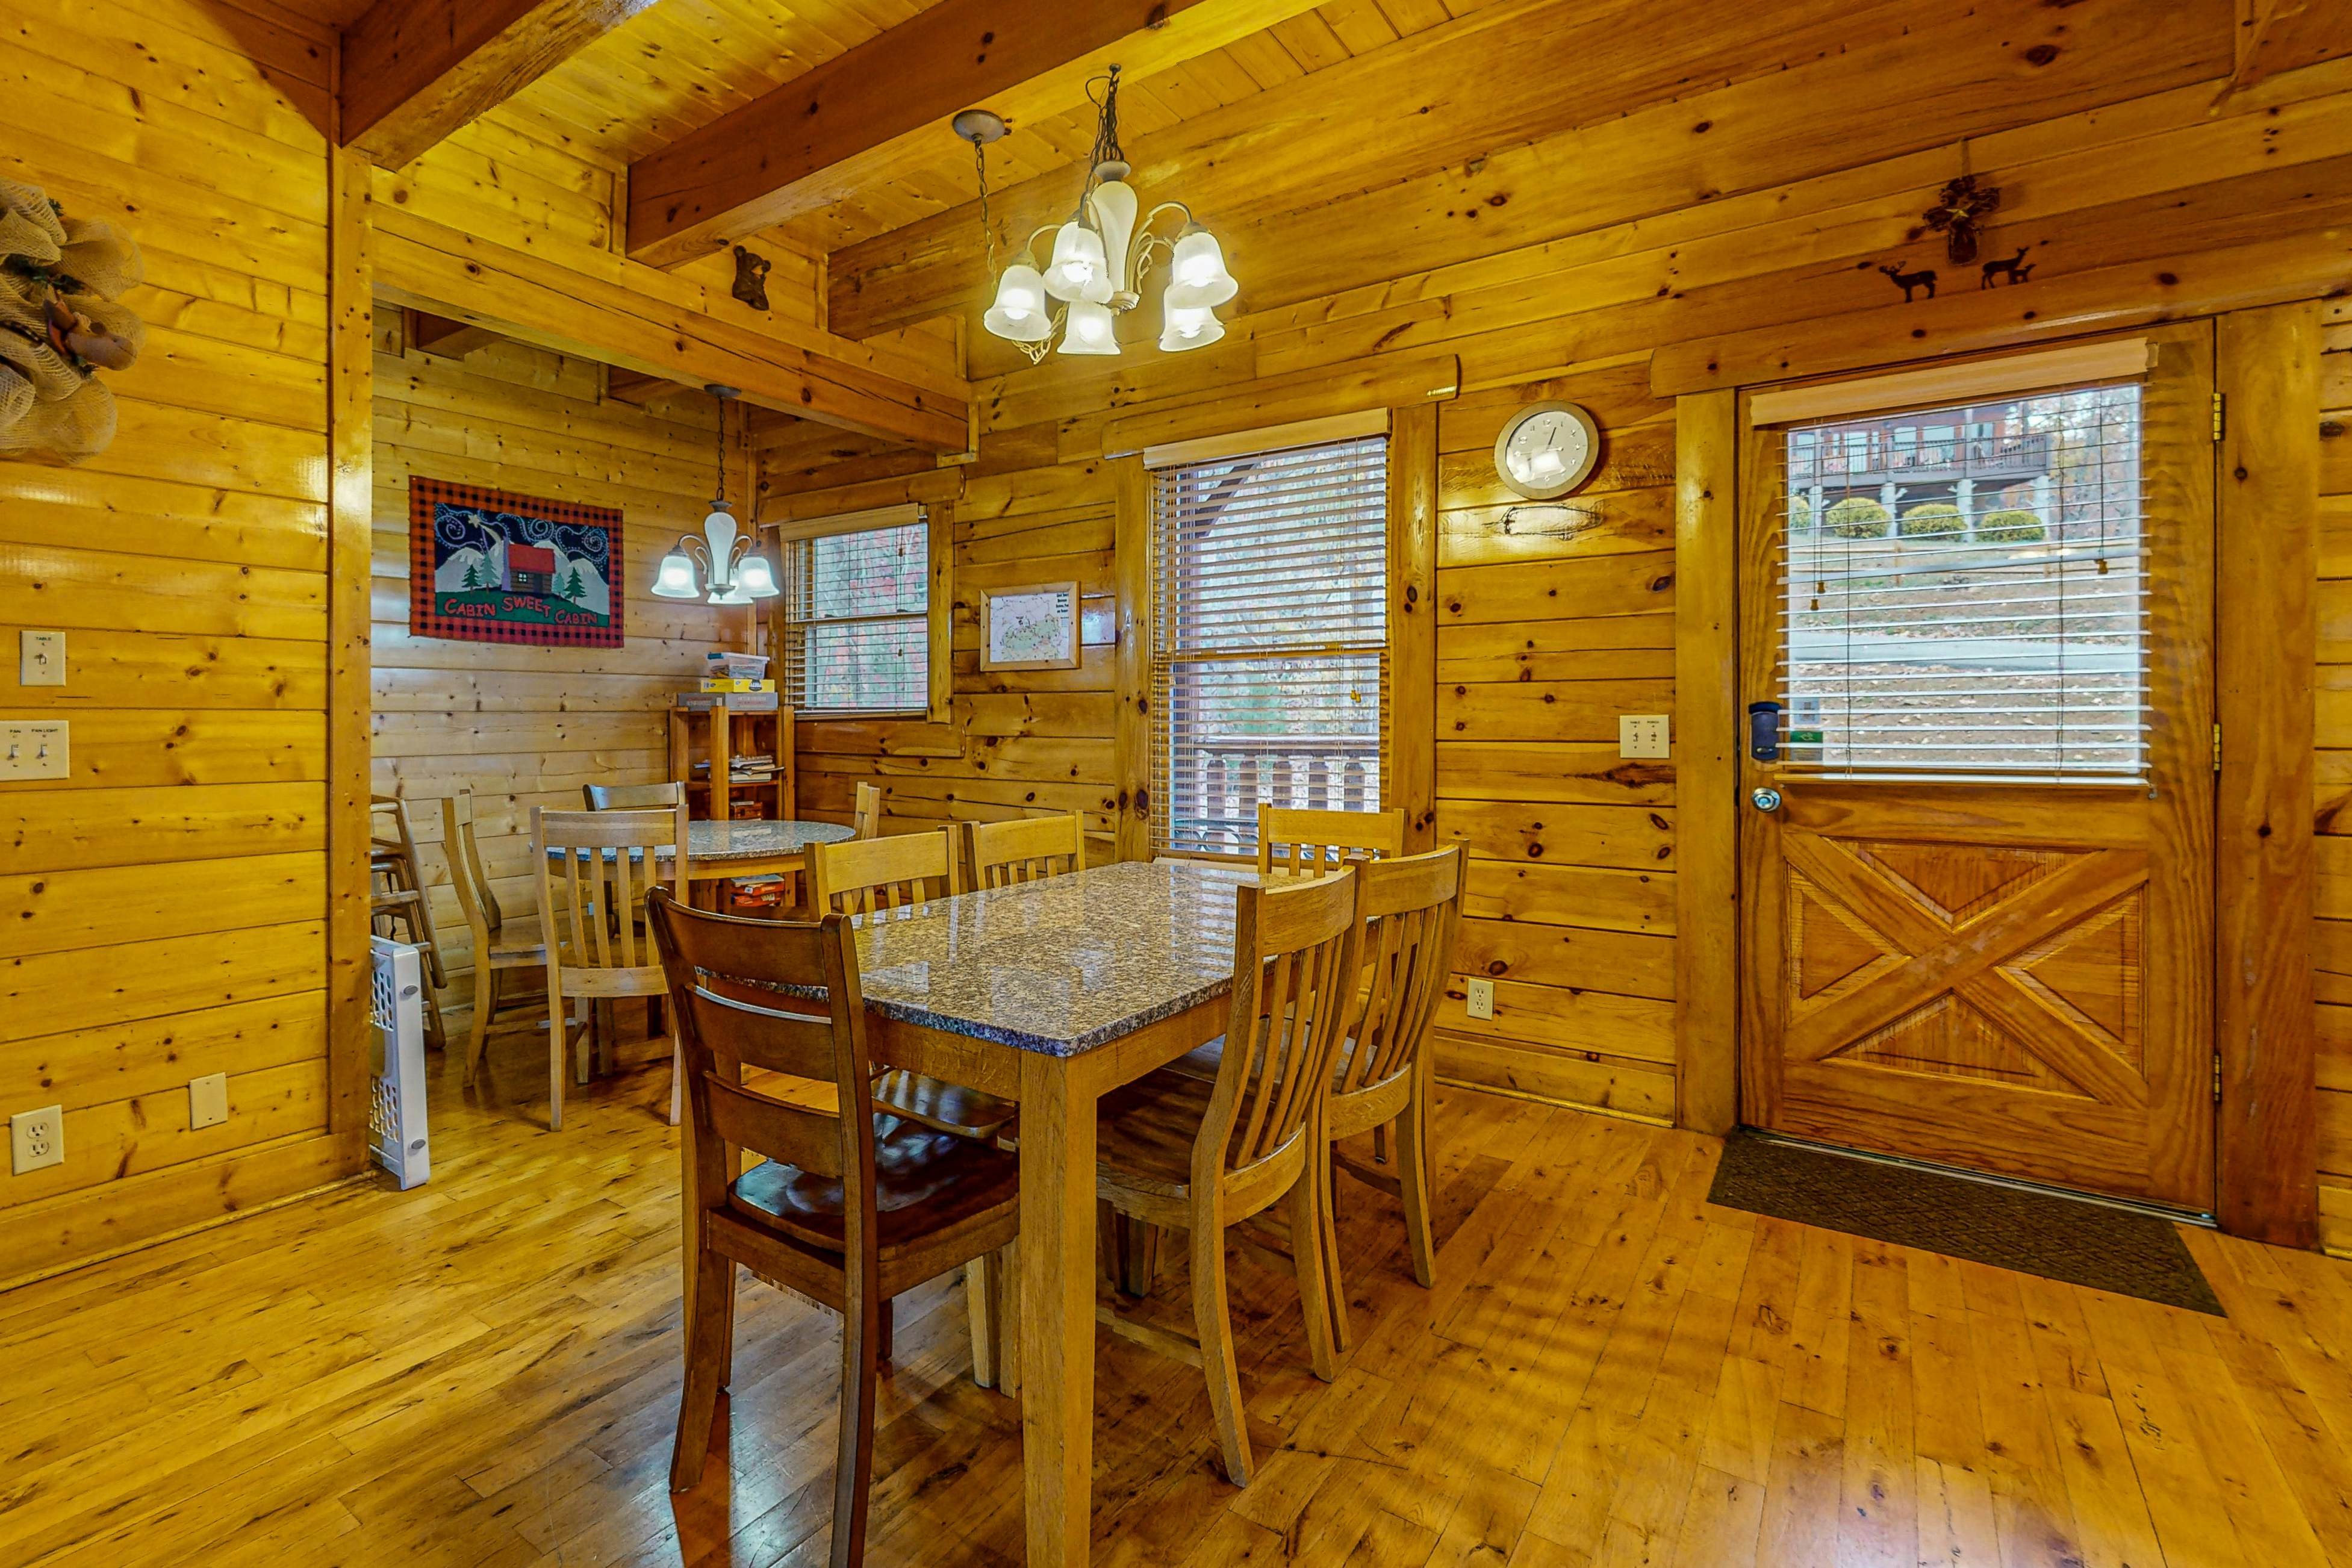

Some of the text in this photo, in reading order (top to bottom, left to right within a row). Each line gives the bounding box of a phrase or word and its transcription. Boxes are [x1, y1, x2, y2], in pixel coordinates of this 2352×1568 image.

[444, 596, 597, 624] CABIN SWEET CABIN
